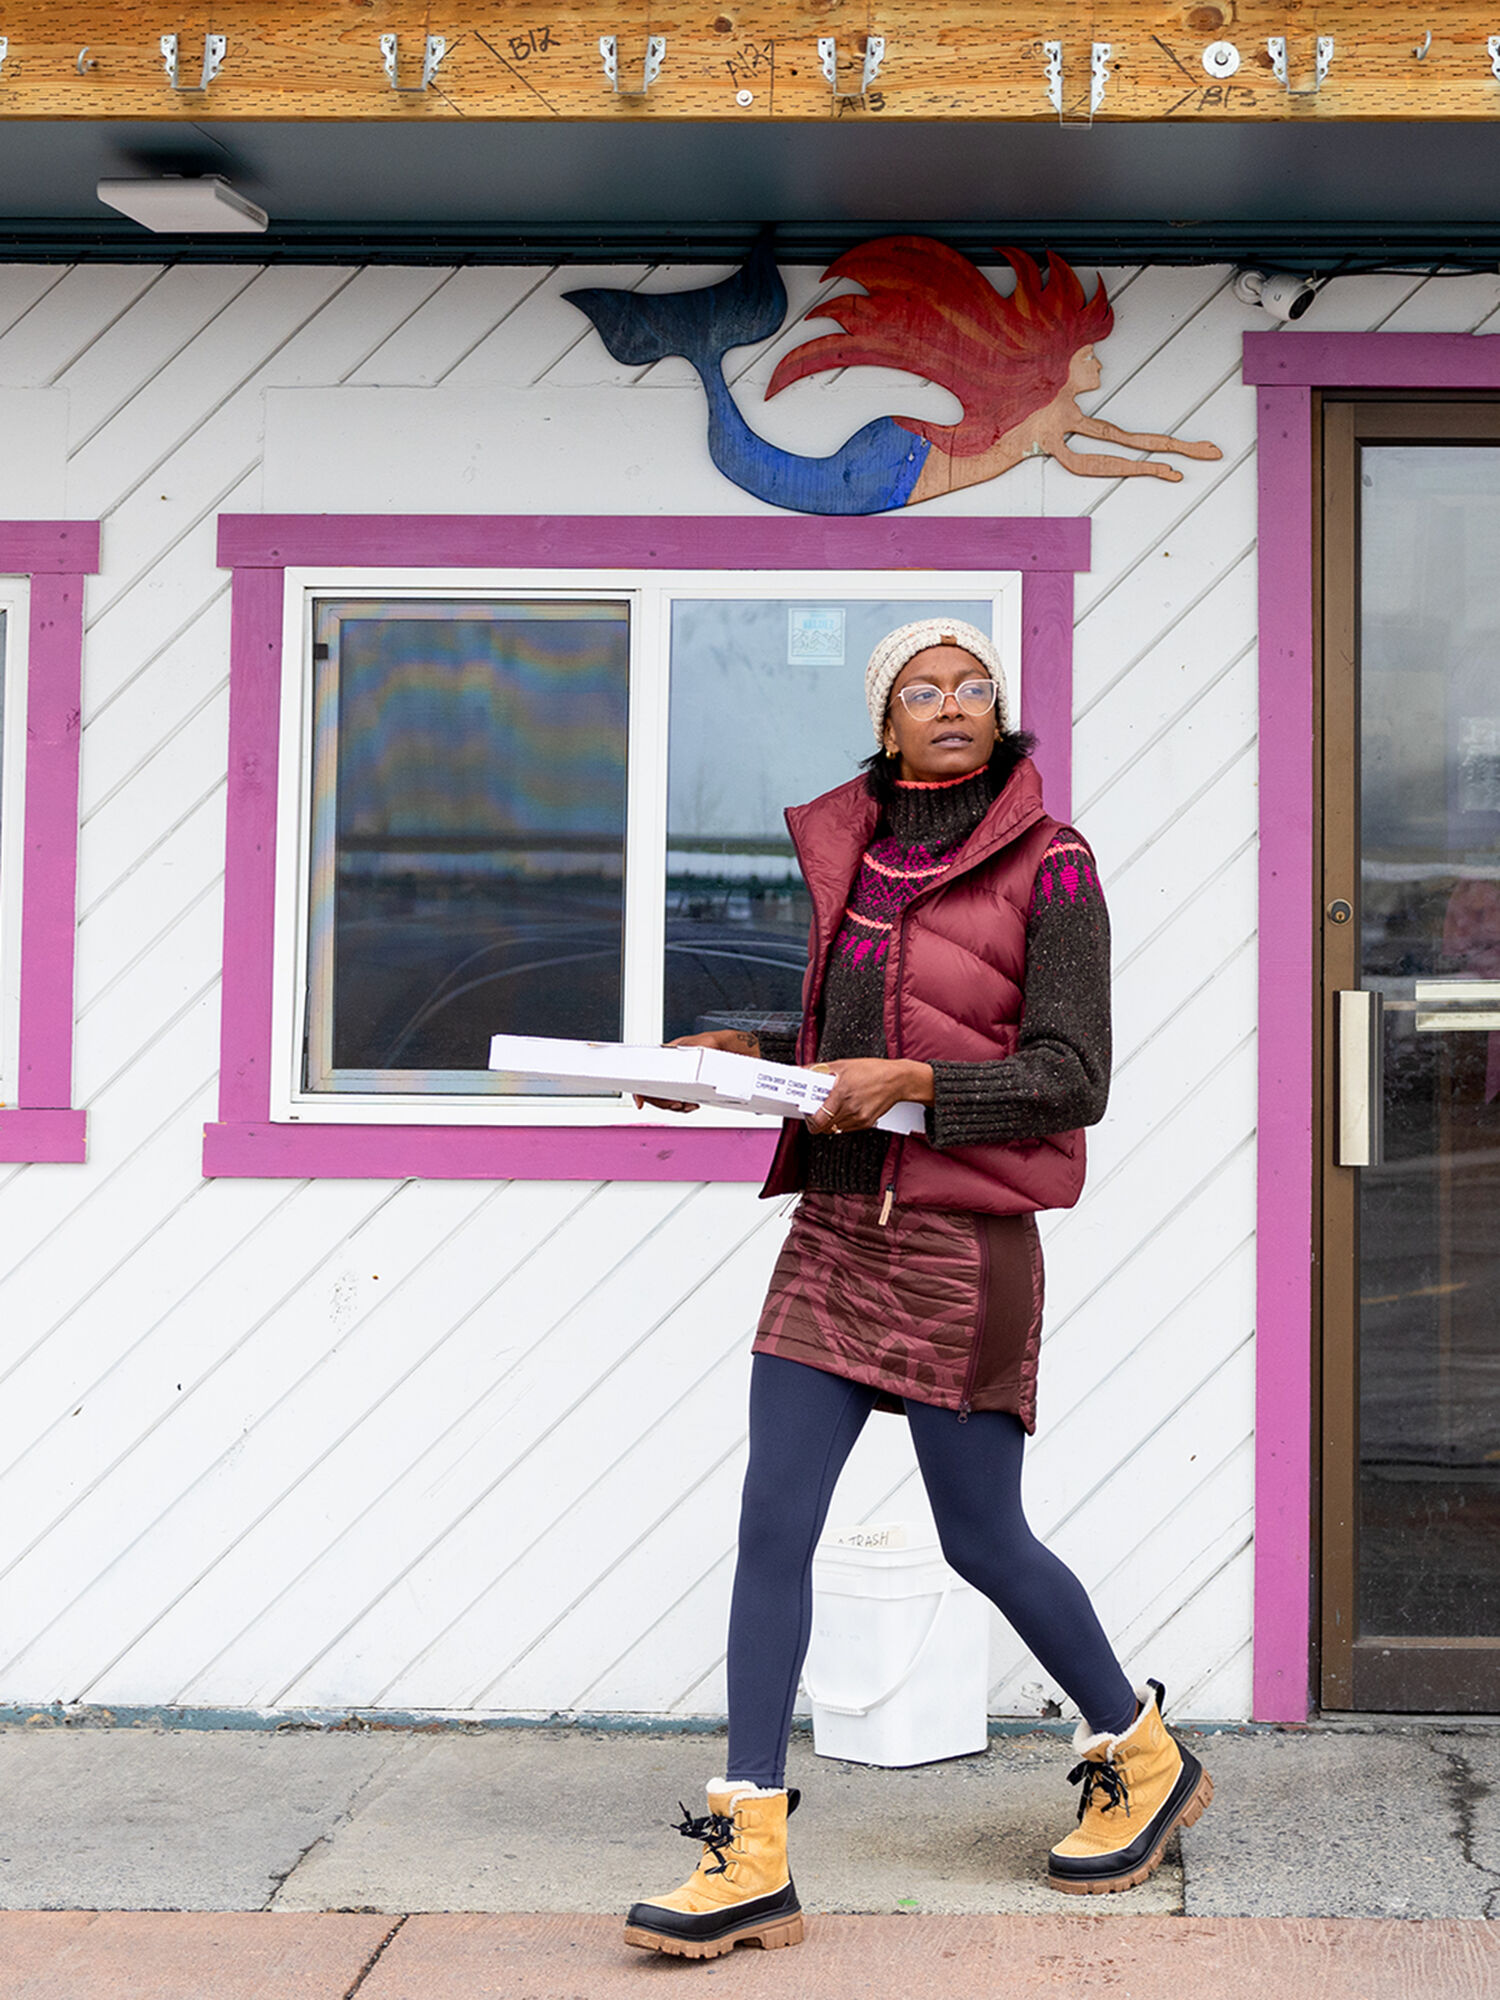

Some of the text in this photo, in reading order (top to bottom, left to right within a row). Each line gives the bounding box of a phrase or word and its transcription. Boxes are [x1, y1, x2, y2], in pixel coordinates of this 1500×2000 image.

[507, 27, 561, 60] B12
[838, 92, 886, 118] A13
[1194, 85, 1257, 111] B13
[848, 1531, 889, 1547] TRASH
